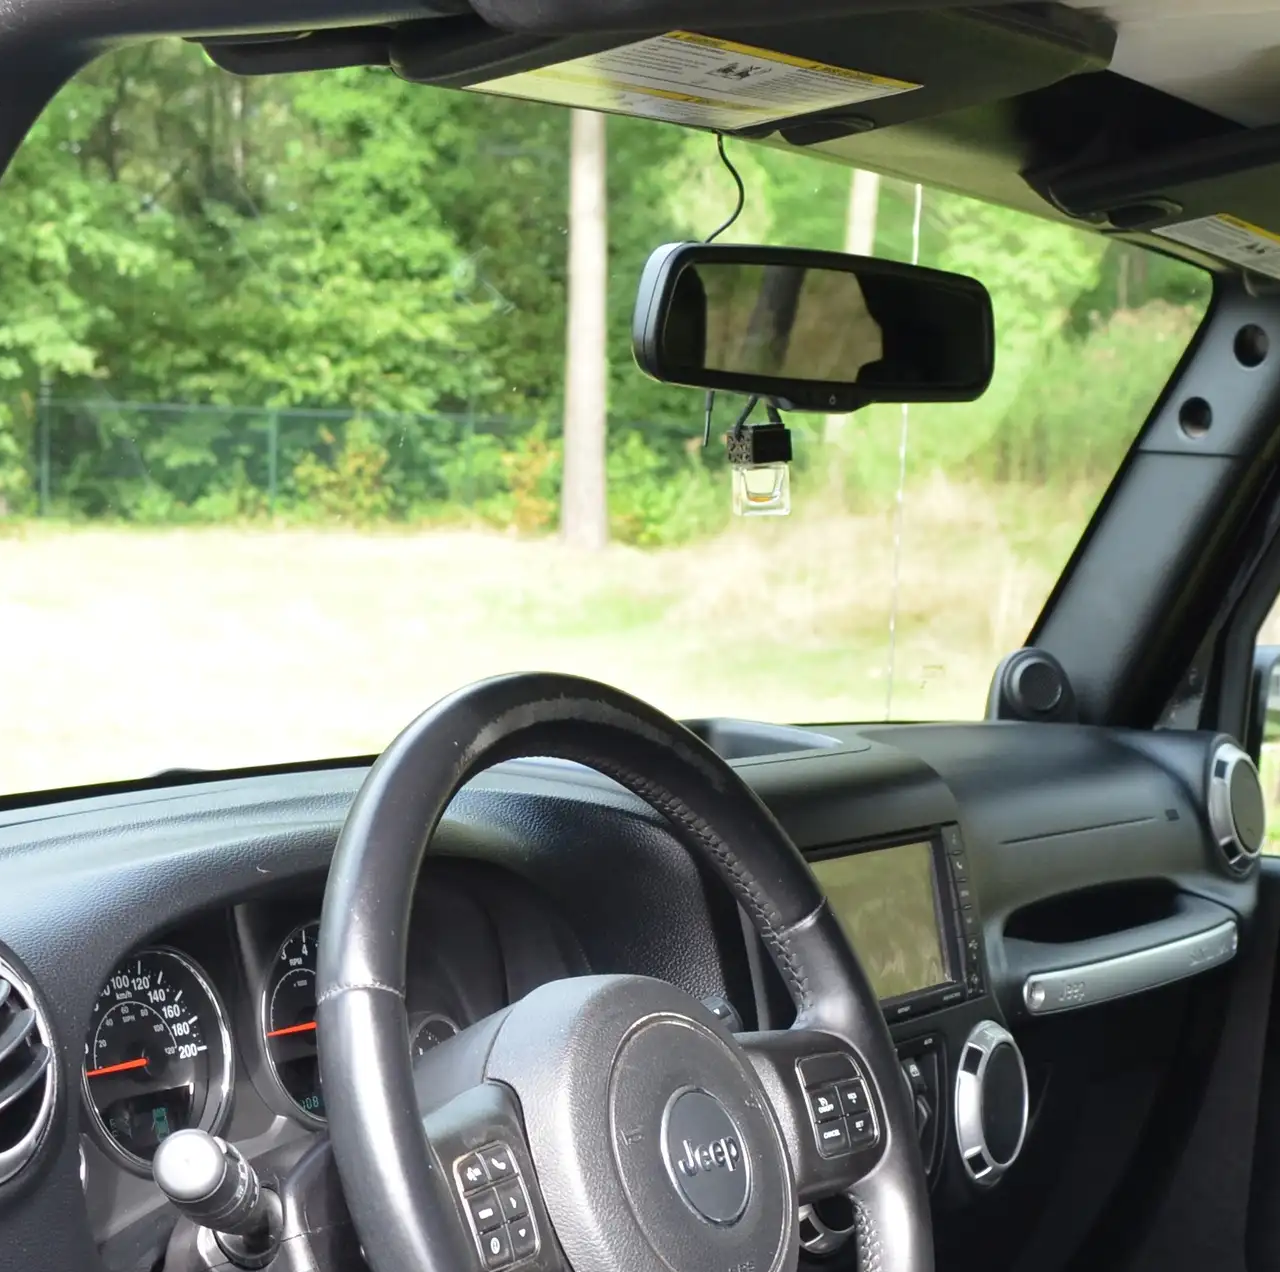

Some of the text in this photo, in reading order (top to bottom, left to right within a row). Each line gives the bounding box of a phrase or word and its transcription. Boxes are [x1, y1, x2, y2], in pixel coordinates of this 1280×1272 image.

[301, 943, 308, 956] 4
[289, 957, 303, 966] RPM
[110, 975, 130, 989] 100
[131, 976, 150, 991] 120
[115, 991, 133, 1000] km/h
[147, 988, 166, 1004] 140
[1058, 980, 1086, 1002] Jeep
[162, 1003, 181, 1019] 160
[172, 1021, 190, 1037] 180
[98, 1039, 107, 1048] 20
[178, 1043, 198, 1059] 200
[677, 1136, 740, 1177] Jeep
